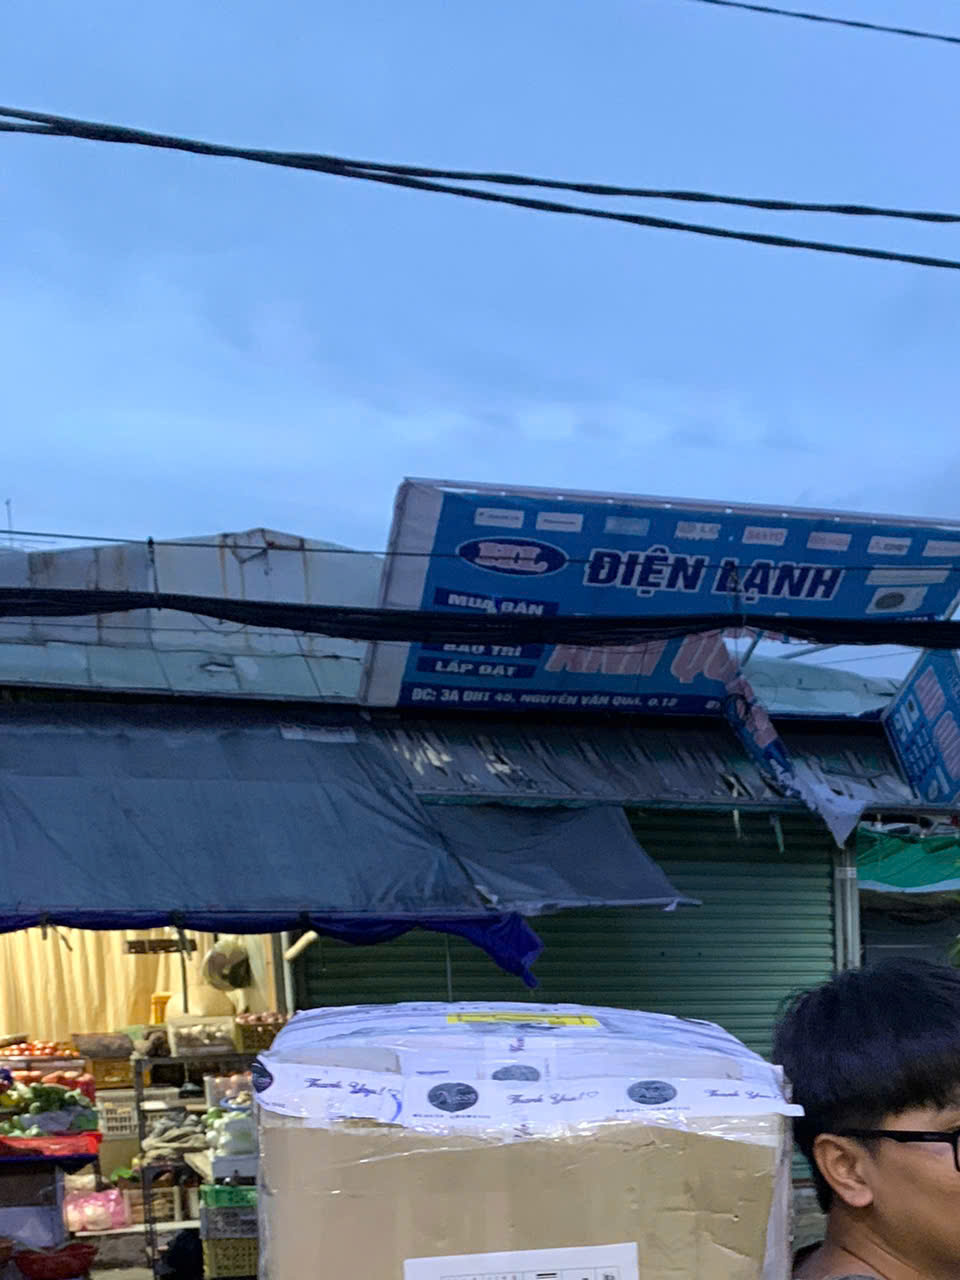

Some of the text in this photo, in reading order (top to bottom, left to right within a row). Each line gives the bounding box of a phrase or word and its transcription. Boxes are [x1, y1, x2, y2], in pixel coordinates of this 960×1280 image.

[583, 545, 708, 597] ĐIỆN
[711, 557, 845, 603] LẠNH
[447, 593, 544, 616] MUA BÁN
[441, 688, 459, 702] 3A
